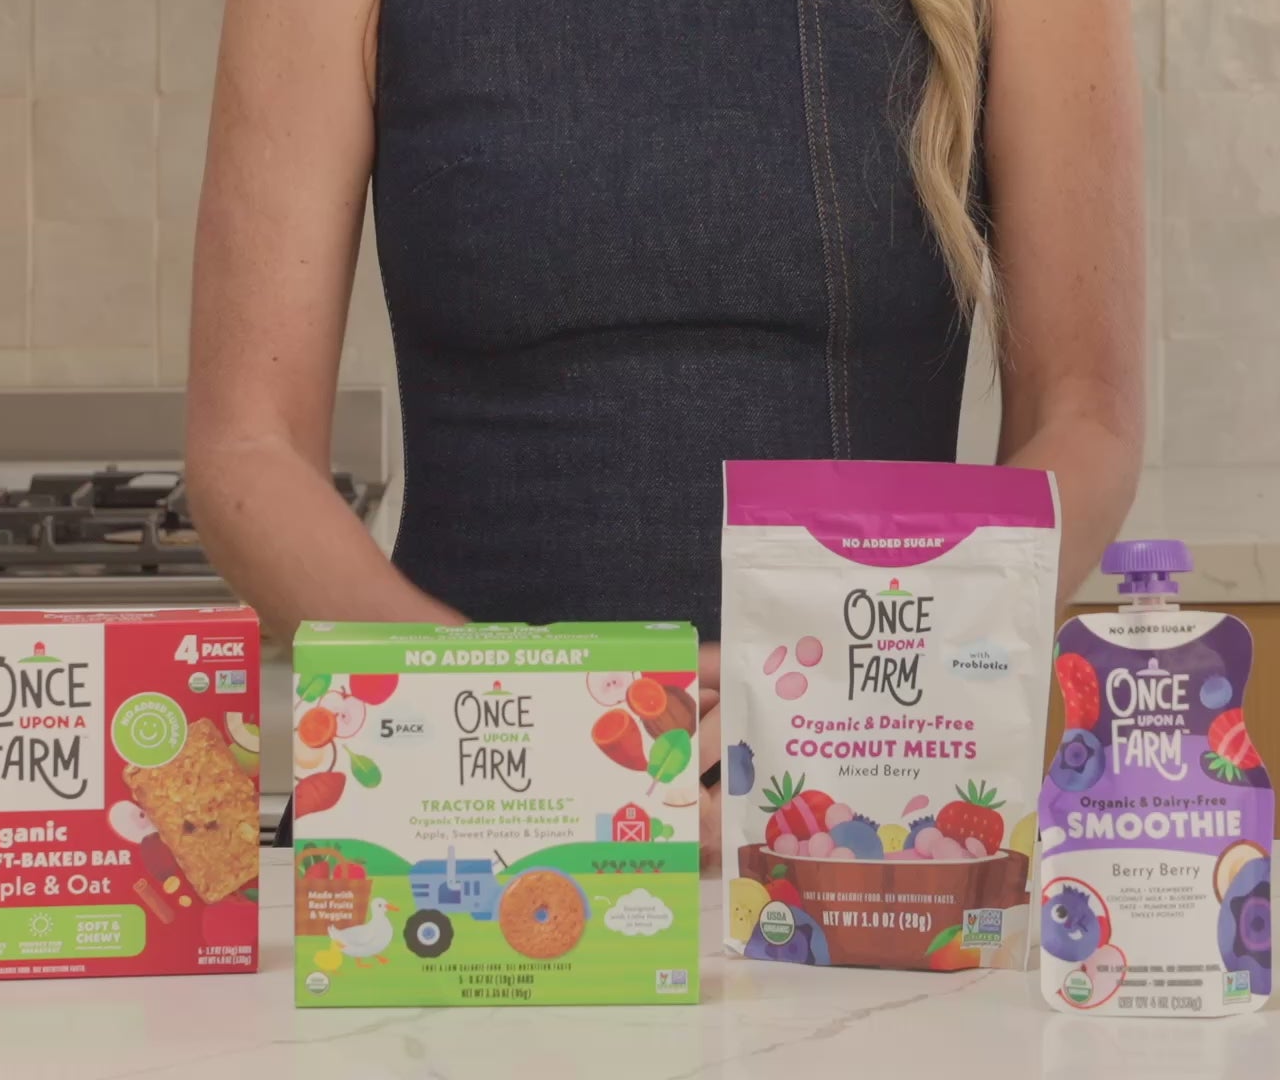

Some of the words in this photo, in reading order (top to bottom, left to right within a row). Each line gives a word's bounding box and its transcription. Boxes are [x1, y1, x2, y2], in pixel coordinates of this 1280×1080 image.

[842, 538, 860, 548] NO
[862, 538, 901, 548] ADDED
[843, 588, 934, 640] ONCE
[1109, 626, 1125, 635] NO
[1127, 625, 1160, 634] ADDED
[174, 634, 199, 665] 4
[201, 642, 244, 658] PACK
[877, 639, 915, 651] UPON
[916, 638, 925, 650] A
[405, 650, 437, 667] NO
[441, 649, 510, 666] ADDED
[970, 651, 990, 659] with
[952, 660, 1008, 671] Probiotics
[1105, 667, 1190, 718] ONCE
[454, 690, 535, 733] ONCE
[20, 716, 69, 730] UPON
[72, 715, 86, 729] A
[791, 715, 860, 733] Organic
[865, 717, 875, 731] &
[879, 716, 974, 733] Dairy-Free
[1136, 715, 1171, 727] UPON
[1172, 714, 1185, 726] A
[379, 719, 394, 739] 5
[395, 723, 424, 734] PACK
[483, 732, 519, 743] UPON
[521, 733, 531, 743] A
[785, 739, 897, 759] COCONUT
[903, 740, 977, 759] MELTS
[838, 765, 877, 777] Mixed
[883, 764, 920, 780] Berry
[421, 799, 496, 812] TRACTOR
[1080, 796, 1136, 812] Organic
[1139, 797, 1148, 808] &
[1152, 795, 1227, 808] Dairy-Free
[409, 816, 452, 827] Organic
[1066, 809, 1242, 840] SMOOTHIE
[452, 830, 484, 839] Sweet
[487, 829, 521, 839] Potato
[523, 829, 531, 838] &
[534, 828, 575, 839] Spinach
[91, 850, 132, 866] BAR
[1111, 863, 1154, 880] Berry
[1159, 863, 1200, 879] Berry
[43, 875, 61, 895] &
[67, 874, 111, 895] Oat
[766, 911, 787, 921] USDA
[822, 911, 840, 926] NET
[842, 912, 858, 926] WT
[861, 912, 879, 927] 1.0
[882, 913, 895, 927] OZ
[898, 912, 932, 932] (28g)
[77, 922, 110, 932] SOFT
[76, 932, 121, 944] CHEWY
